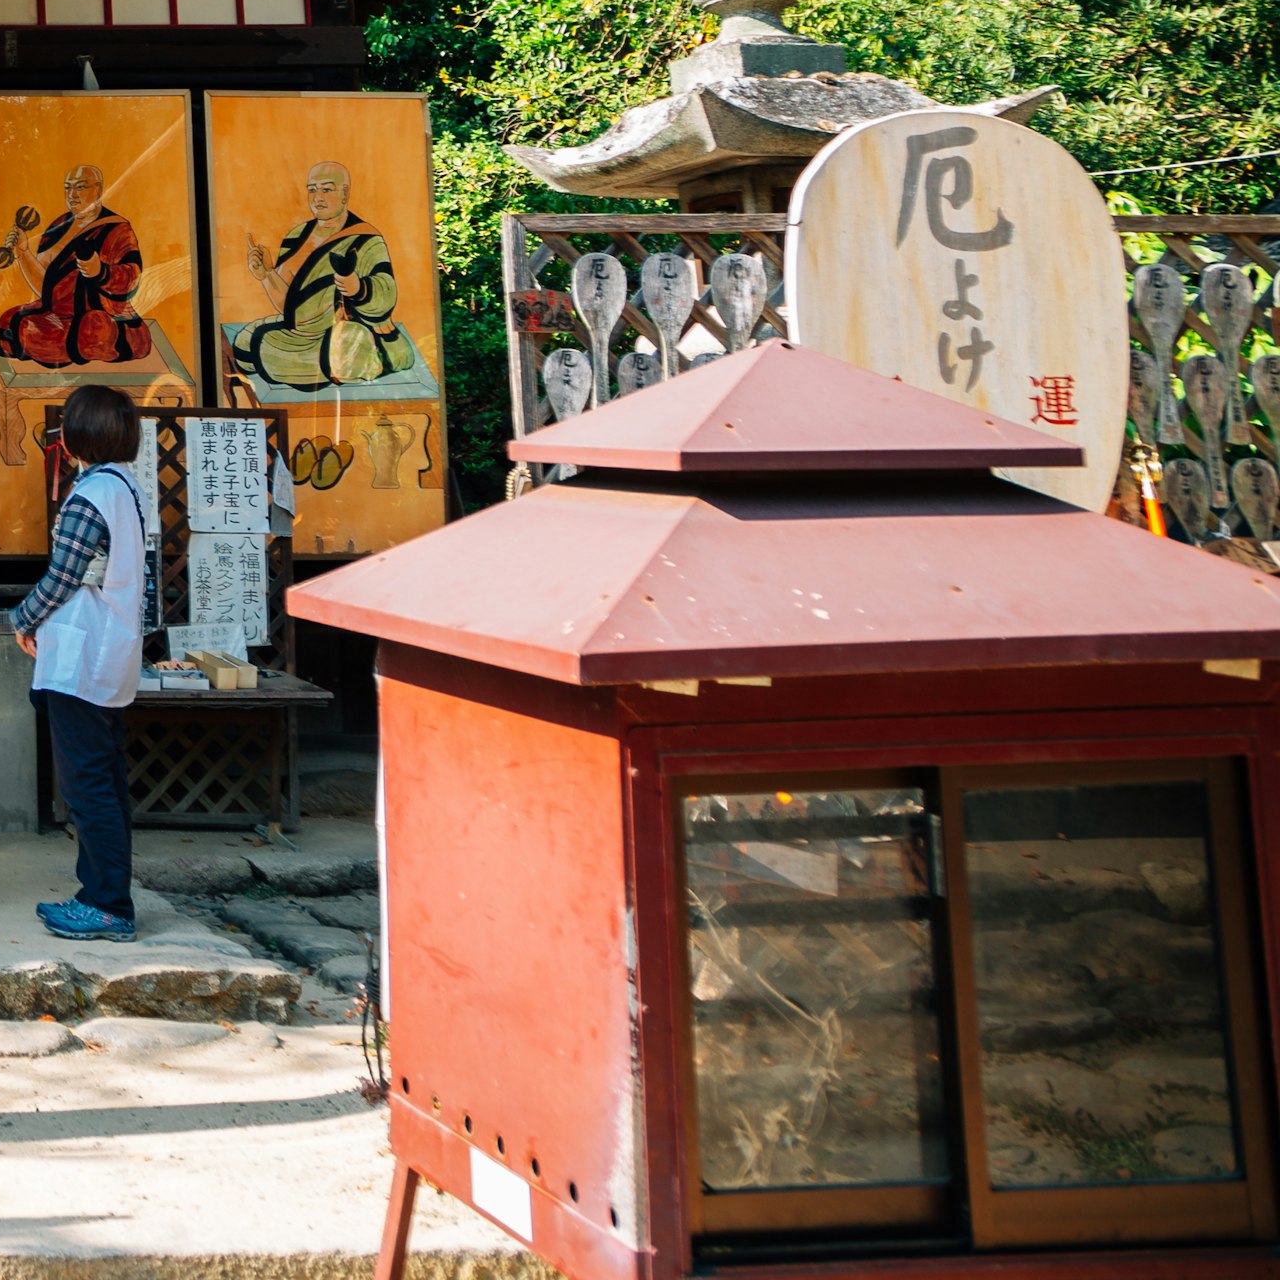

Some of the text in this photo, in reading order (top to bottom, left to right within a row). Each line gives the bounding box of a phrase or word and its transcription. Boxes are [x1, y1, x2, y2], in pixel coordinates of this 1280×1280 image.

[896, 126, 1014, 392] 厄よけ
[1028, 374, 1079, 426] 運
[200, 422, 220, 508] 恵まれます
[220, 422, 241, 525] 帰ると子宝に
[241, 421, 260, 508] 石を頂いて
